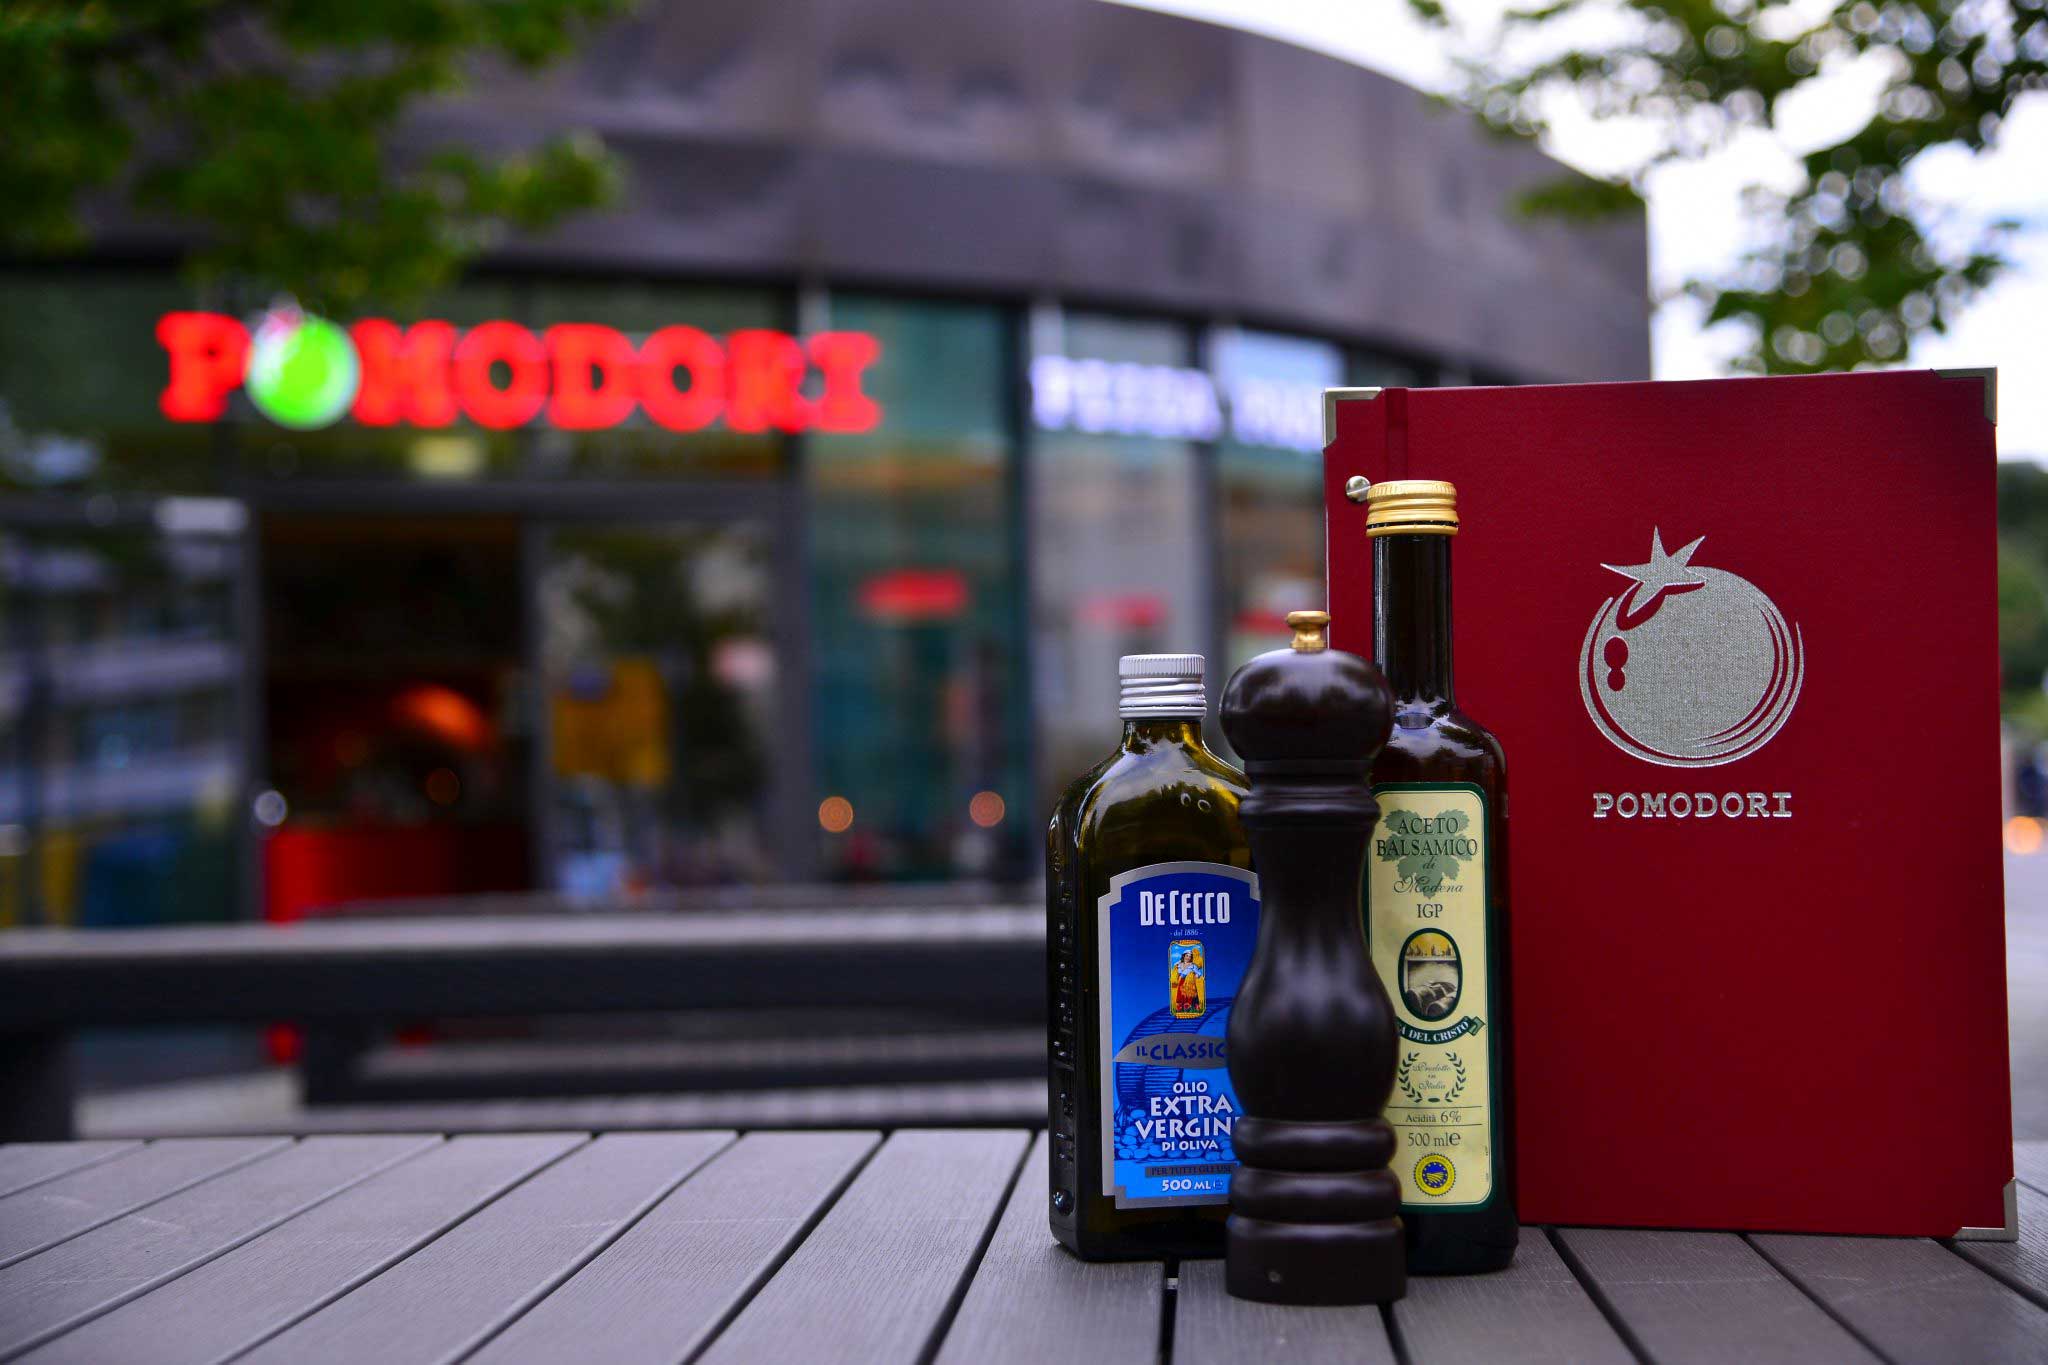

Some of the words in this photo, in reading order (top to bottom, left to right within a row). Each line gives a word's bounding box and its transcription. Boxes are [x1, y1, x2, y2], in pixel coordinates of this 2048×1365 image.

[1593, 791, 1793, 819] POMODORI
[1398, 817, 1460, 835] ACETO
[1376, 838, 1478, 857] BALSAMICO
[1423, 856, 1436, 870] di
[1393, 875, 1464, 894] Modena
[1416, 903, 1444, 919] IGP
[1408, 1029, 1431, 1042] DEL
[1433, 1021, 1469, 1042] CRISTO
[1136, 1045, 1148, 1057] IL
[1149, 1042, 1226, 1060] CLASSIC
[1173, 1081, 1208, 1094] OLIO
[1150, 1094, 1233, 1117] EXTRA
[1405, 1114, 1437, 1123] Acidità
[1440, 1110, 1462, 1123] 6%
[1135, 1117, 1240, 1140] VERGIN
[1162, 1140, 1176, 1151] DI
[1178, 1139, 1219, 1151] OLIVA
[1407, 1132, 1430, 1147] 500
[1161, 1178, 1193, 1192] 500
[1194, 1180, 1212, 1190] ML
